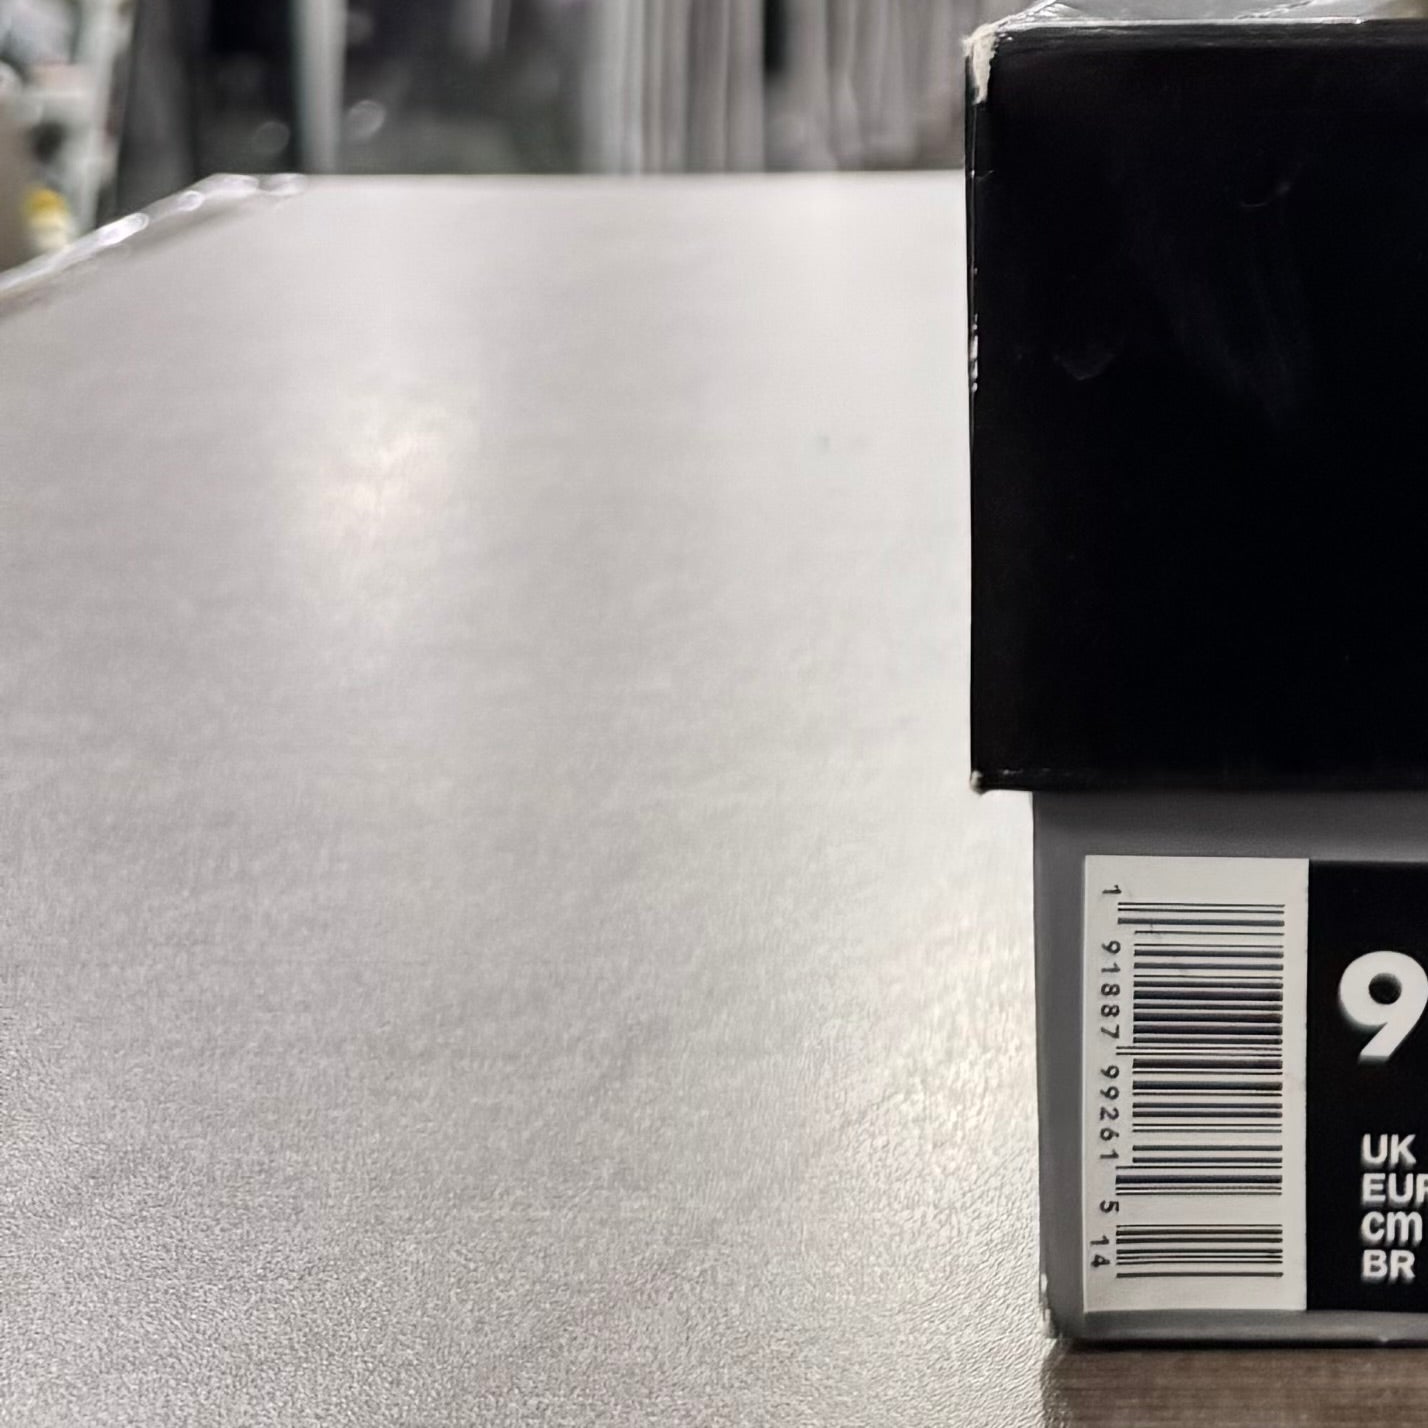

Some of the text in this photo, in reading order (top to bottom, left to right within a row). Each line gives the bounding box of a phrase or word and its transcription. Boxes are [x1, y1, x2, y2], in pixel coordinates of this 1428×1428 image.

[1100, 940, 1121, 1039] 91887
[1099, 1065, 1120, 1161] 99261
[1362, 1133, 1418, 1167] UK
[1362, 1249, 1416, 1282] BR
